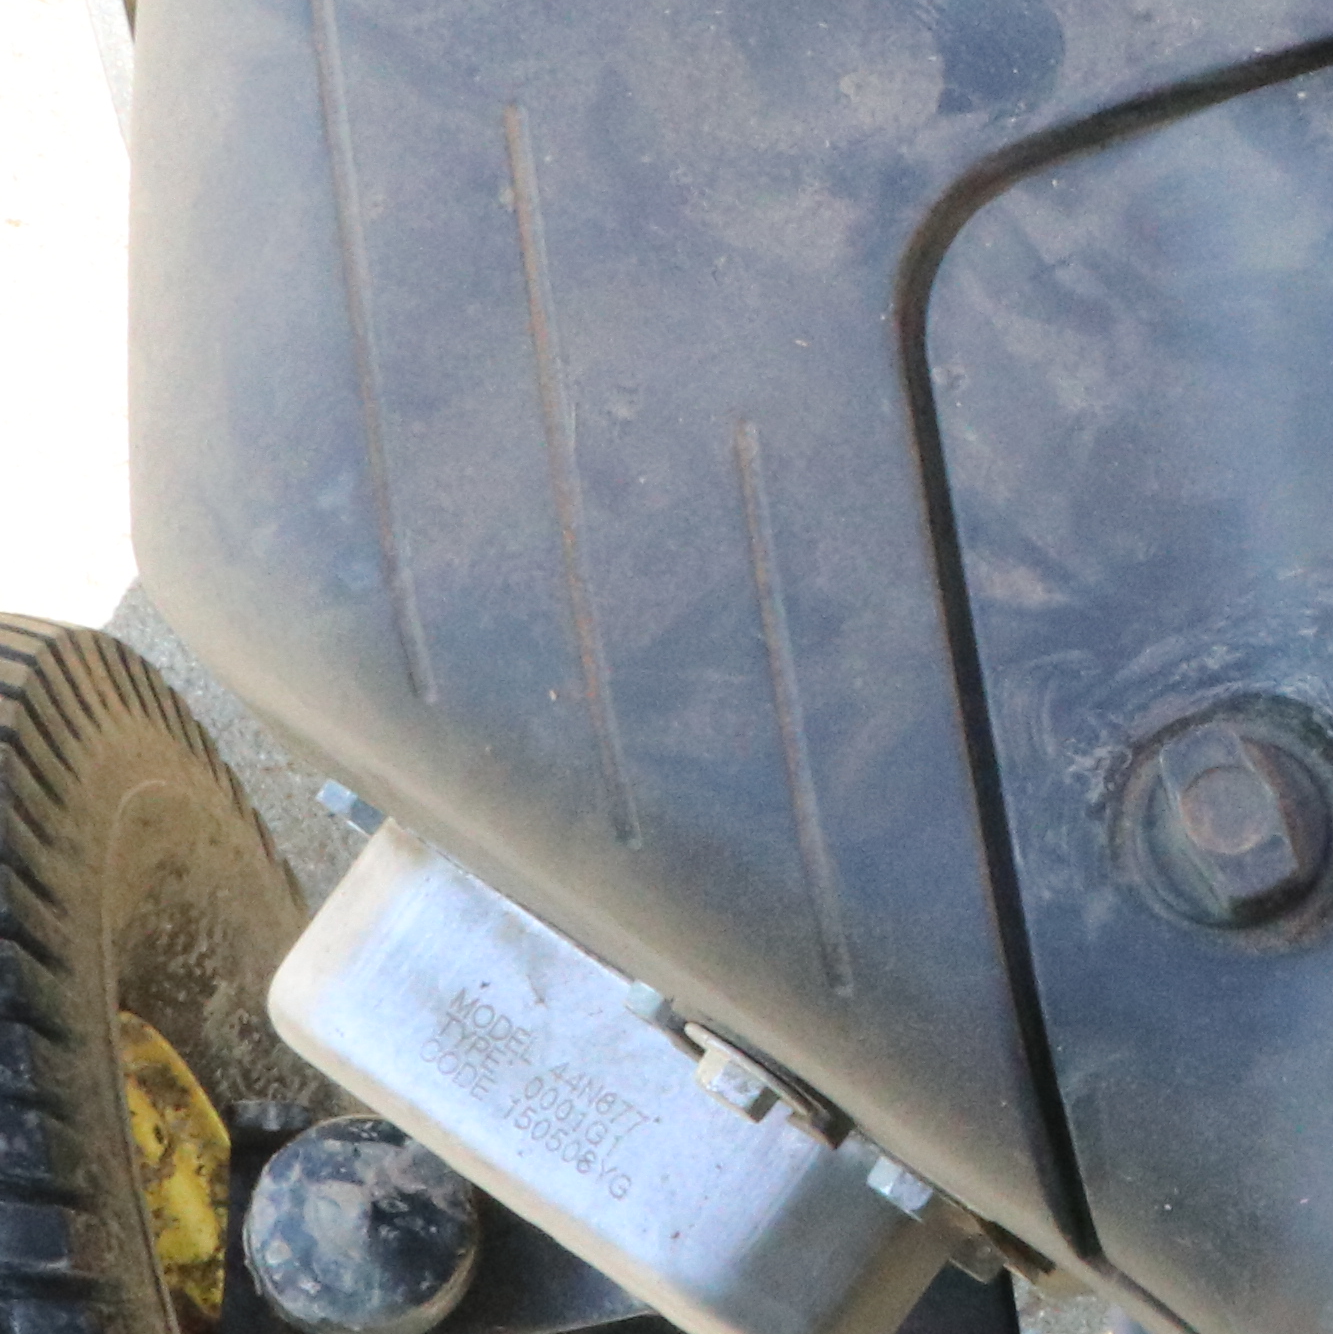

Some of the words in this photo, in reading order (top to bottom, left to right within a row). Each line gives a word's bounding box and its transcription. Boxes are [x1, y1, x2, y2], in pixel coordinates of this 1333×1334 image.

[448, 987, 532, 1066] MODEL
[420, 1039, 495, 1101] CODE
[503, 1095, 632, 1200] 150508YG
[524, 1076, 622, 1156] 0001G1
